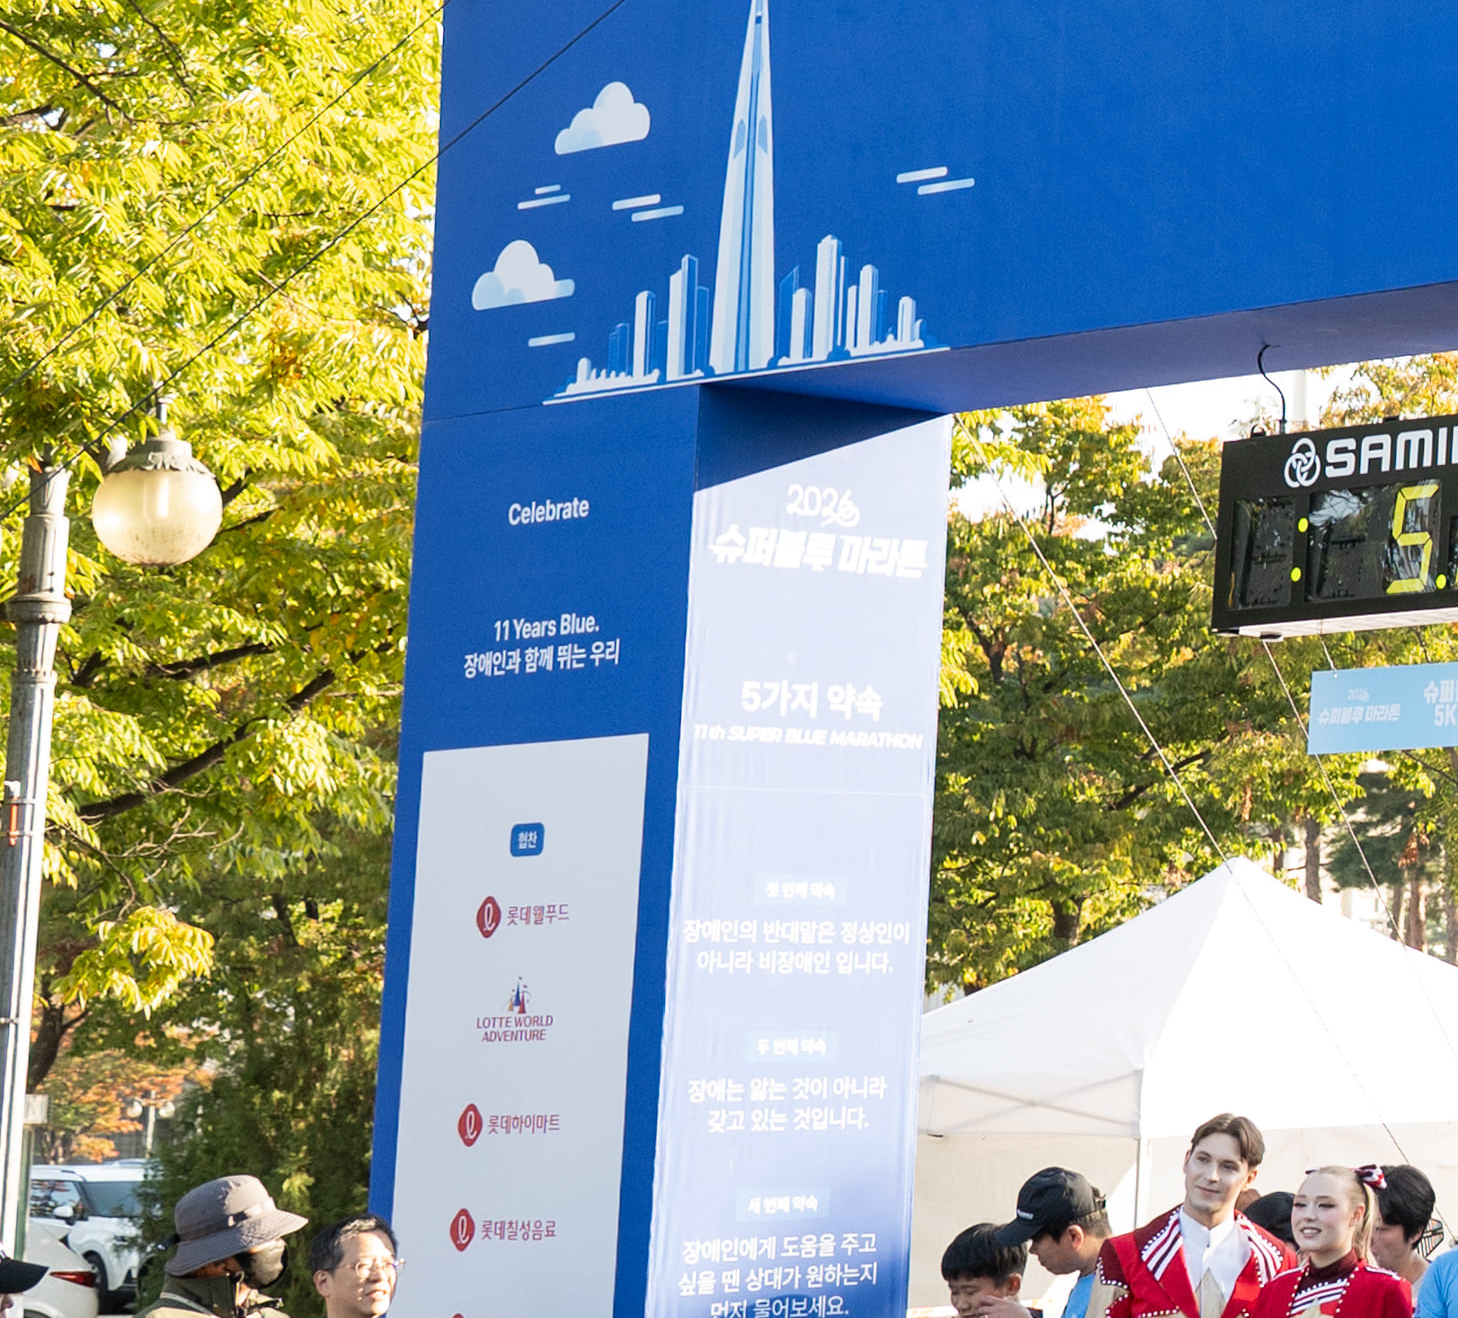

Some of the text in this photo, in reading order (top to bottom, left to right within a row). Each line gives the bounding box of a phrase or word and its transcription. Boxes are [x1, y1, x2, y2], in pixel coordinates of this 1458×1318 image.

[508, 496, 589, 526] Celebrate
[786, 483, 860, 527] 2026
[710, 523, 928, 578] 슈퍼블루 마라톤
[494, 613, 599, 638] 11 Years Blue.
[464, 639, 620, 677] 장애인과 함께 뛰는 우리
[742, 681, 883, 721] 5가지 약속
[728, 726, 781, 743] SUPER
[785, 727, 827, 745] BLUE
[830, 729, 922, 749] MARATHON
[518, 831, 537, 849] 협찬
[507, 904, 569, 925] 롯데웰푸드
[683, 920, 910, 945] 장애인의 반대말은 정상인이
[697, 951, 893, 974] 아니라 비장애인 입니다.
[476, 1015, 553, 1029] LOTTE WORLD
[482, 1029, 546, 1042] ADVENTURE
[689, 1078, 743, 1101] 장애는
[792, 1077, 827, 1099] 것이
[832, 1076, 886, 1098] 아니라
[488, 1112, 560, 1135] 롯데하이마트
[707, 1107, 869, 1132] 갖고 있는 것입니다.
[481, 1218, 556, 1241] 롯데칠성음료
[682, 1233, 876, 1263] 장애인에게 도움을 주고
[679, 1262, 878, 1297] 싶을 땐 상대가 원하는지
